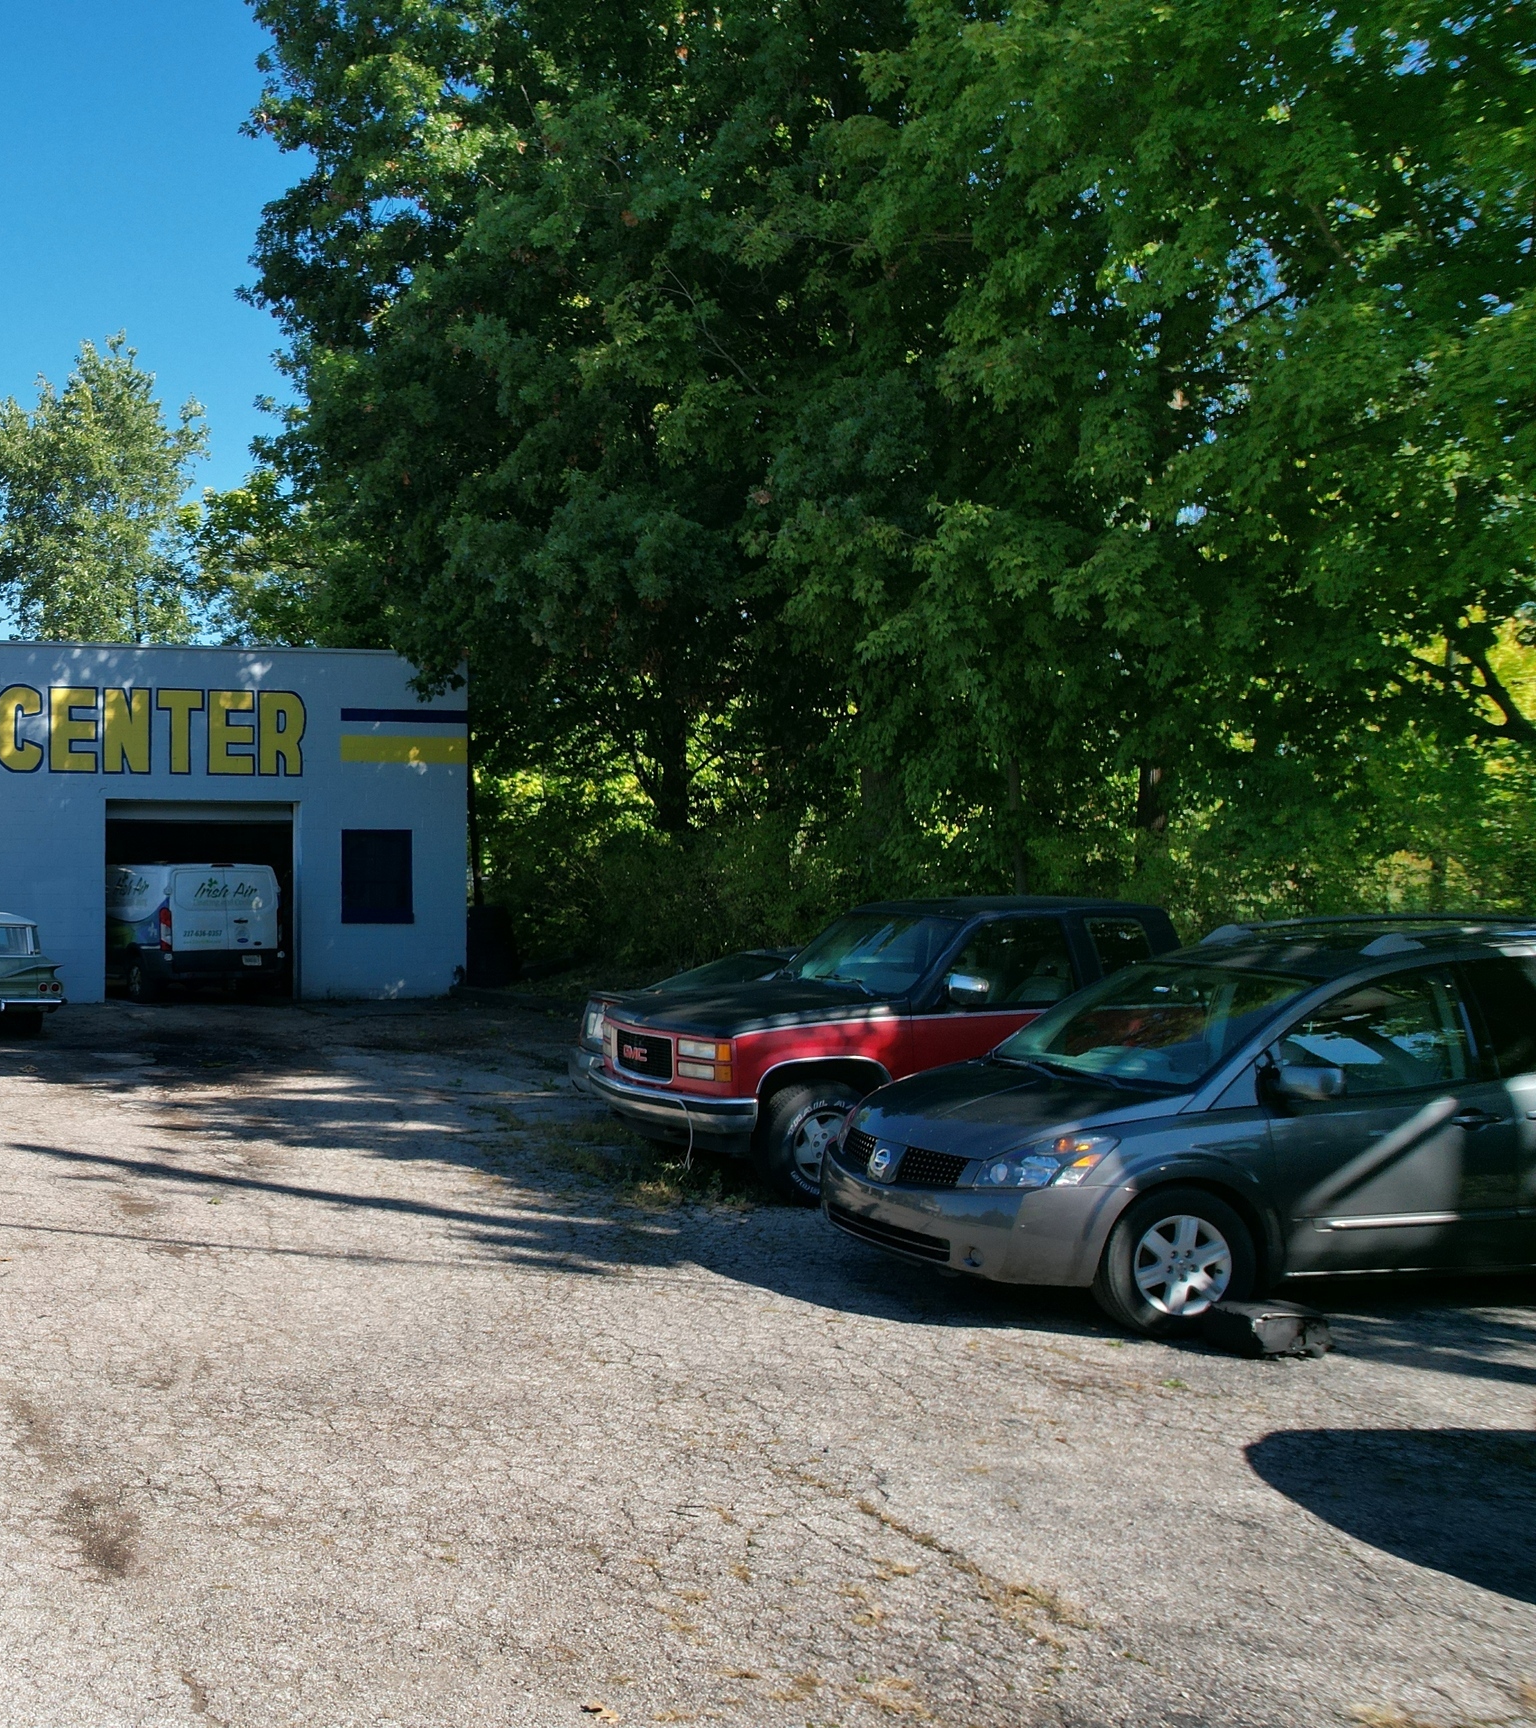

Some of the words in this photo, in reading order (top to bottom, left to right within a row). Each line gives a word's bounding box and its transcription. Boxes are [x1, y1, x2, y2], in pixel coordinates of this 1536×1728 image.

[194, 882, 229, 898] Irish
[233, 882, 258, 898] Air
[623, 1044, 647, 1062] GMC
